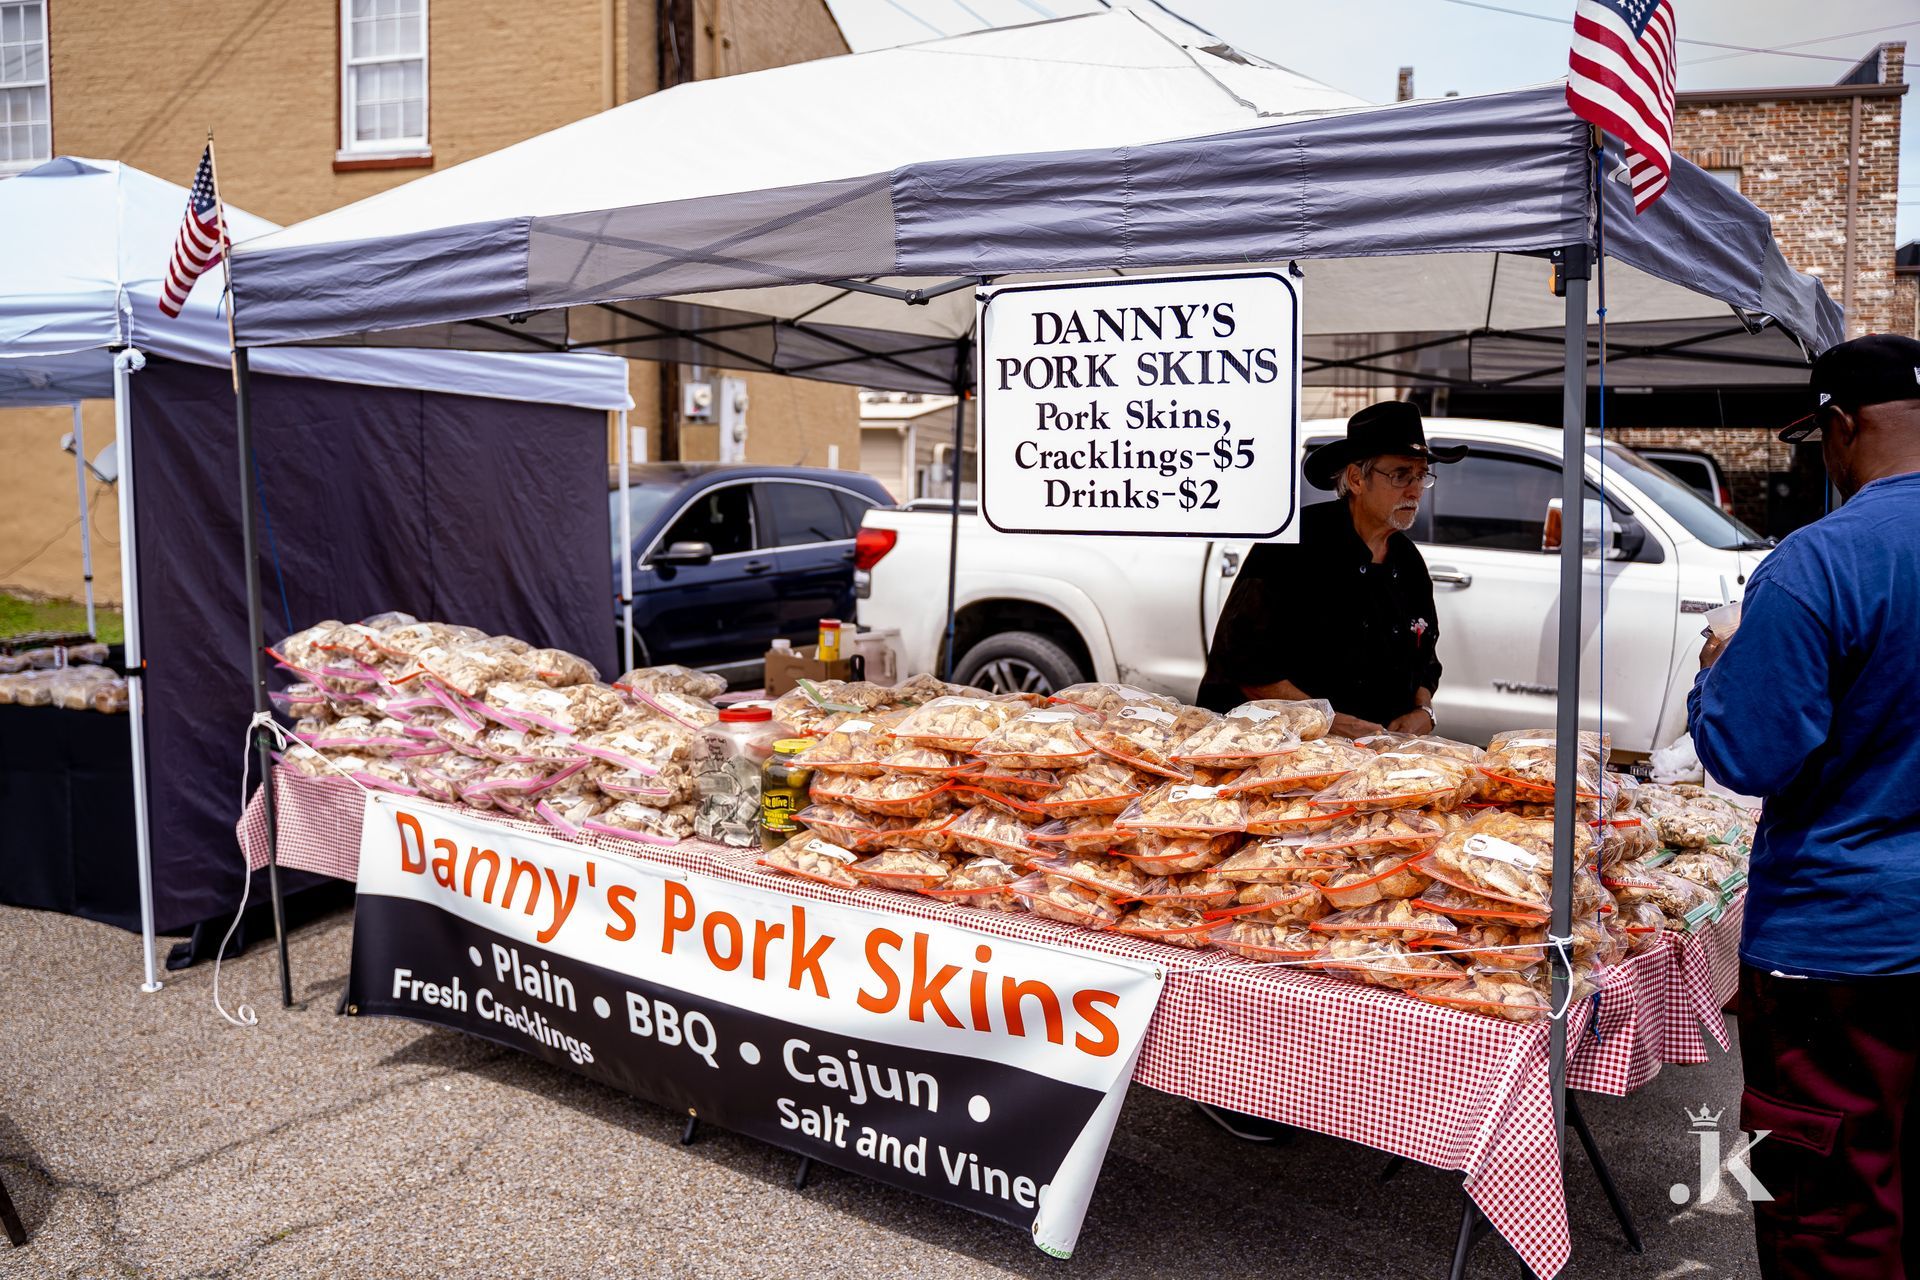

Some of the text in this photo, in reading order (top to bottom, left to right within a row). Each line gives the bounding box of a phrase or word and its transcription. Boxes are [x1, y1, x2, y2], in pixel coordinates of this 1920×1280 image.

[1032, 303, 1236, 345] DANNY'S
[997, 348, 1278, 390] PORK SKINS
[1036, 399, 1231, 436] Pork Skins,
[396, 811, 1121, 1057] Danny's Pork Skins
[393, 967, 595, 1065] Fresh Cracklings
[492, 943, 939, 1113] Plain BBQ Cajun
[777, 1097, 850, 1148] Salt
[856, 1126, 928, 1177] and
